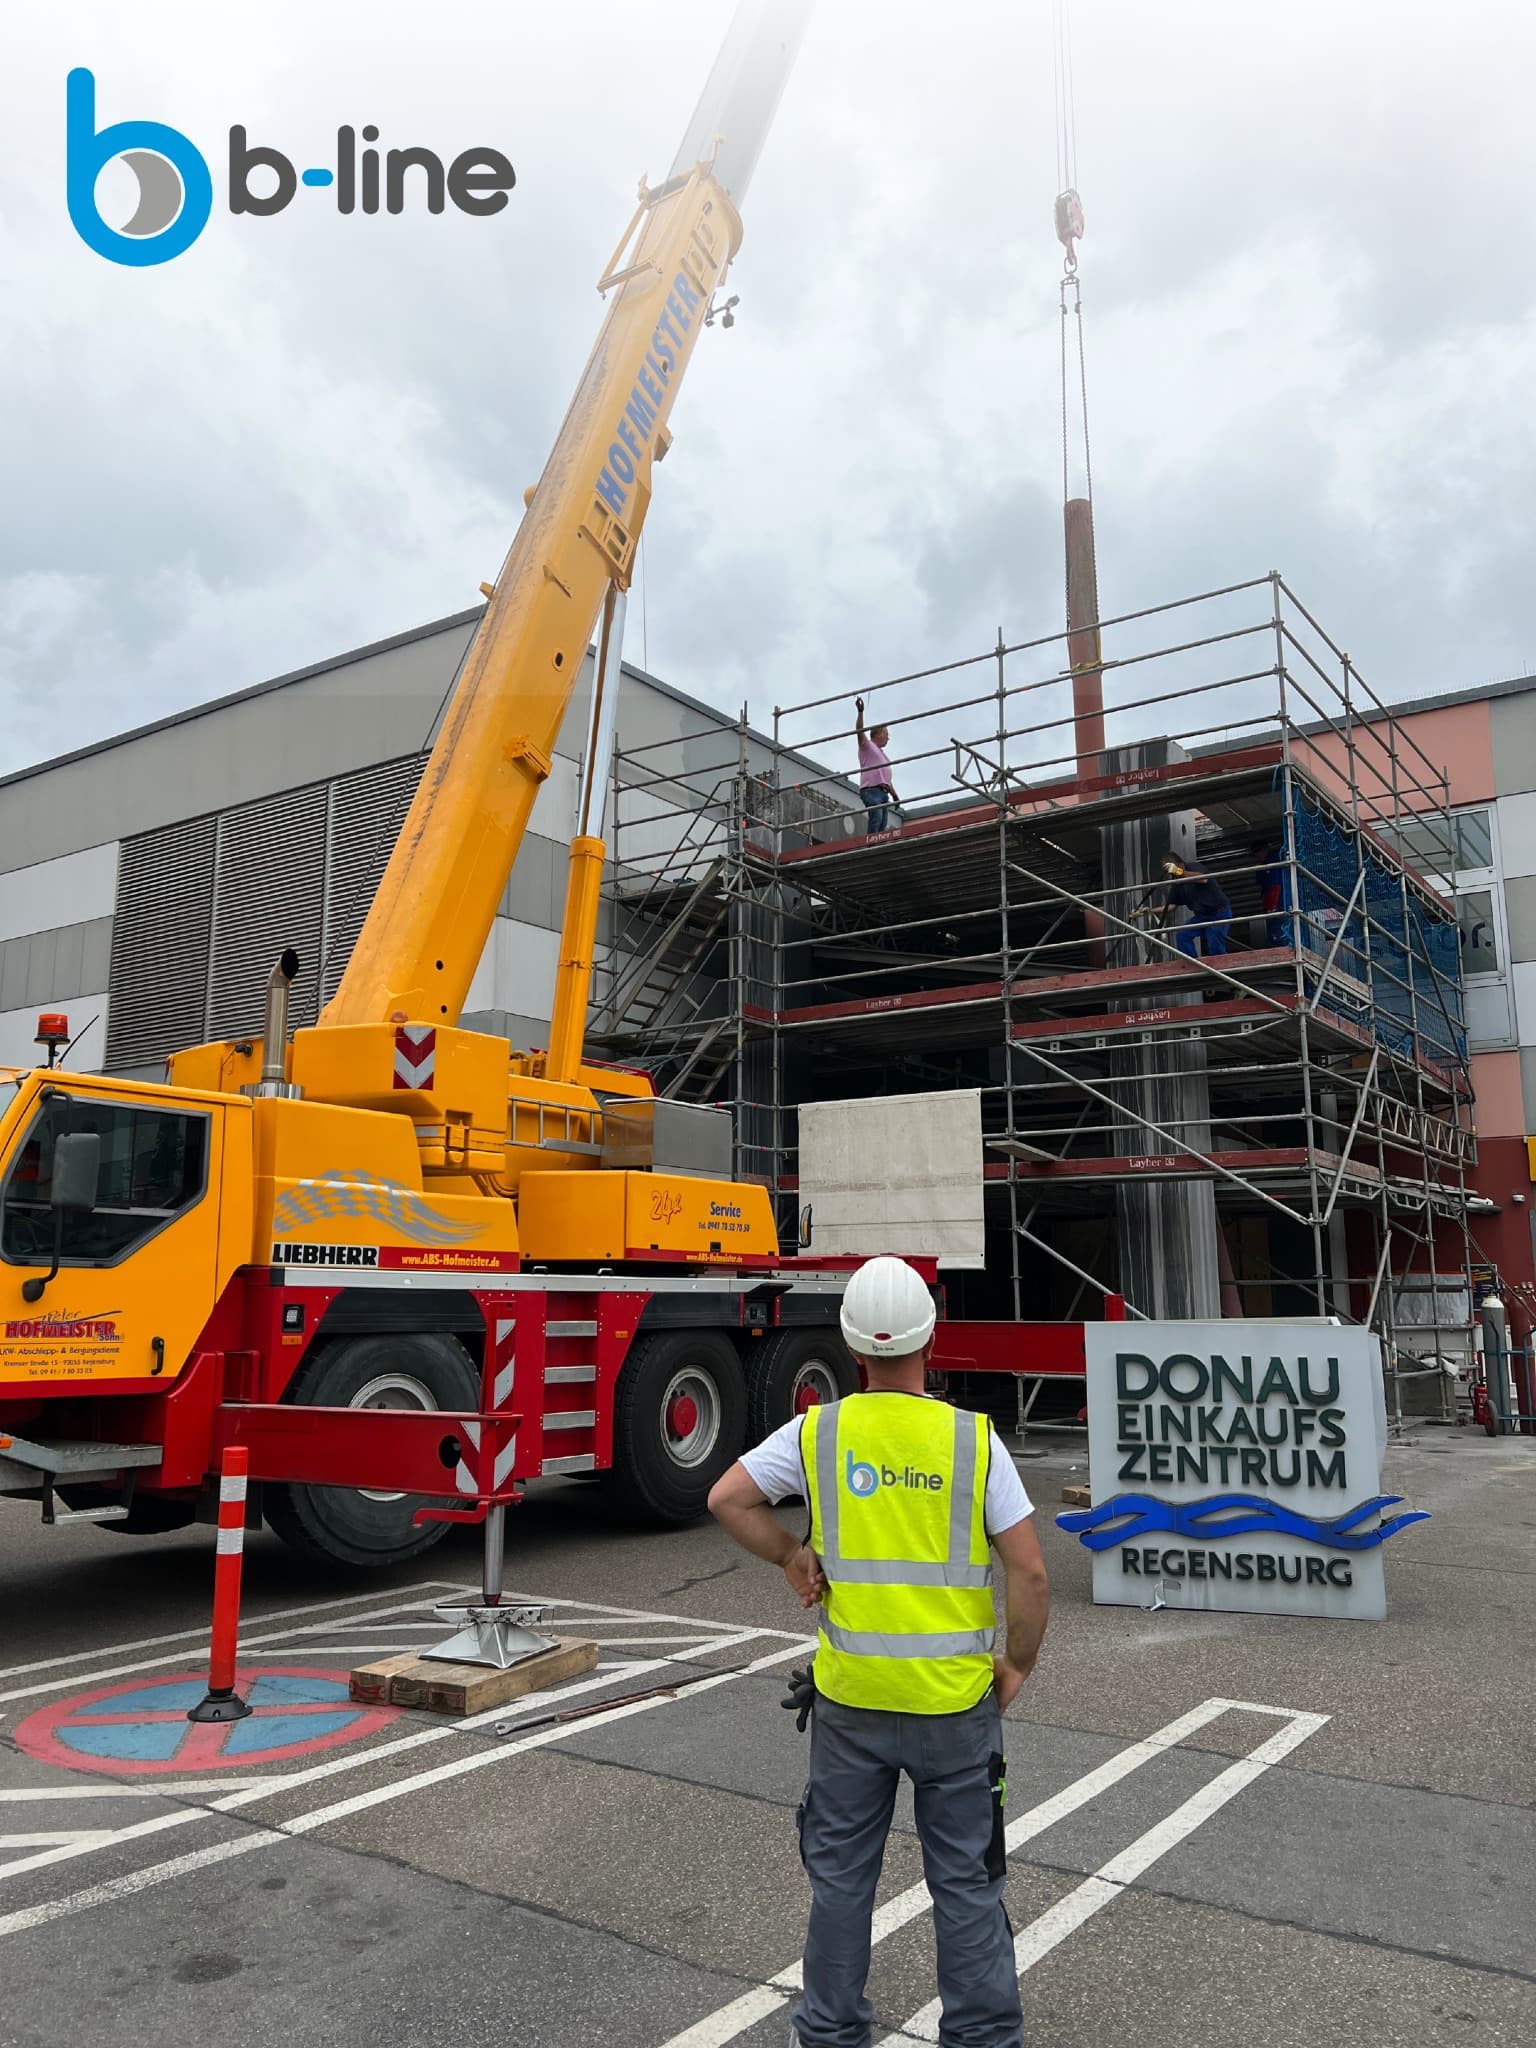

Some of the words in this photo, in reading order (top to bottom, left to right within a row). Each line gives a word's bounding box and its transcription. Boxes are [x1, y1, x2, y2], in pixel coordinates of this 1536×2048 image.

[596, 271, 699, 516] HOFMEISTER
[1129, 1158, 1161, 1169] Layher
[710, 1201, 741, 1218] Service
[272, 1244, 377, 1266] LIEBHERR
[402, 1253, 500, 1268] www.ABS-Hofmeister.de
[5, 1321, 116, 1338] HOFMEISTER
[1115, 1353, 1340, 1406] DONAU
[1117, 1403, 1347, 1447] EINKAUFS
[881, 1464, 944, 1491] b-line
[1117, 1444, 1347, 1489] ZENTRUM
[1121, 1547, 1353, 1587] REGENSBURG
